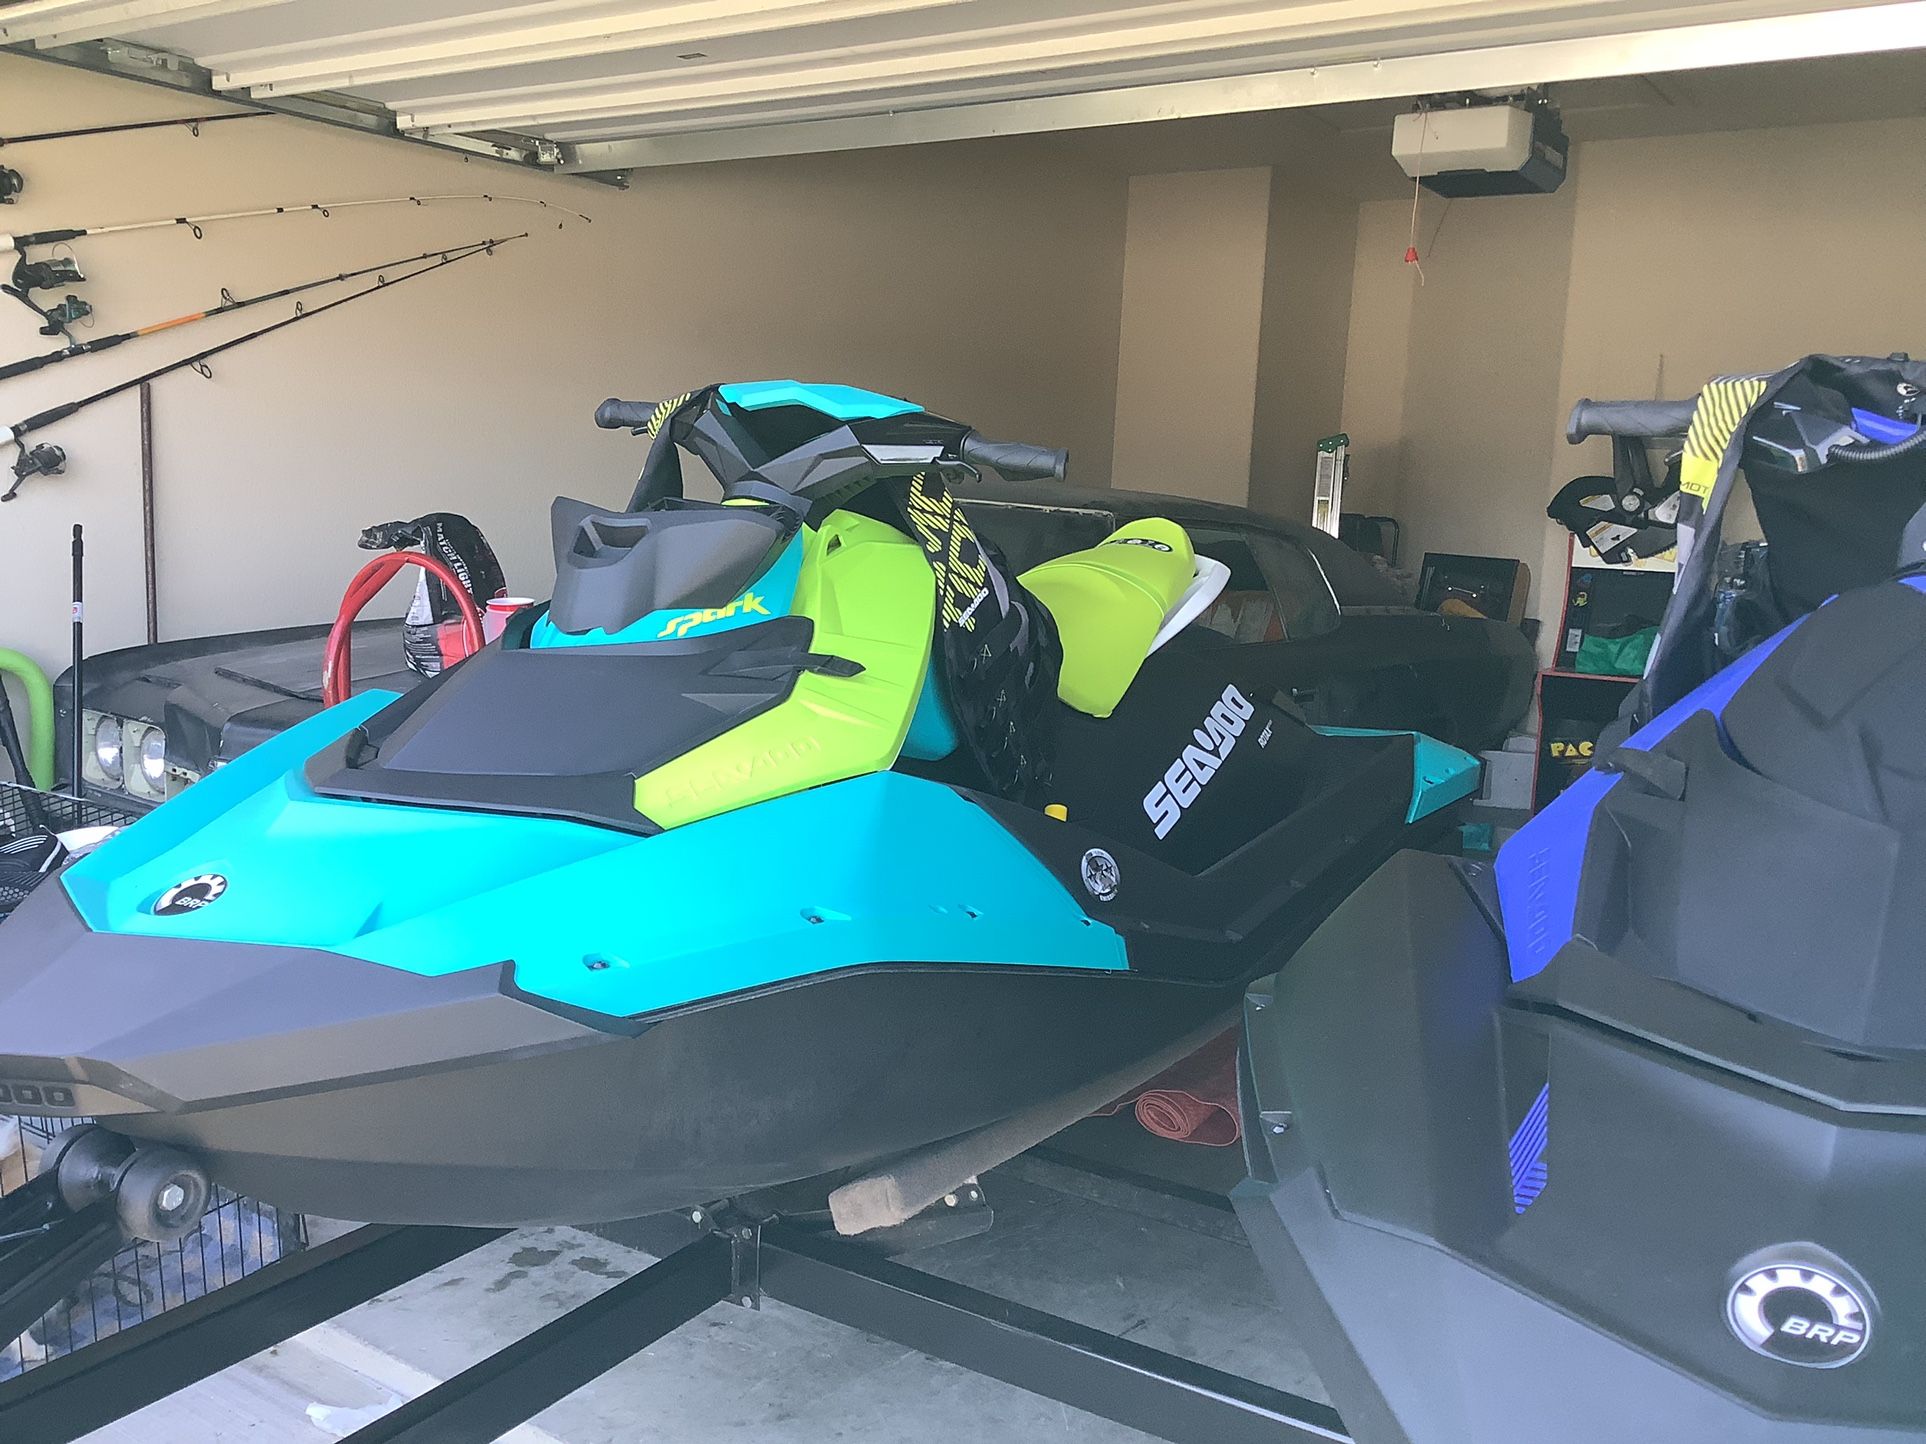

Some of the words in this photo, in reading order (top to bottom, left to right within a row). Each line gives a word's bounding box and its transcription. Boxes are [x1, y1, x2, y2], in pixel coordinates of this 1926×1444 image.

[436, 522, 456, 561] MATCH
[1550, 741, 1594, 757] PAC
[174, 896, 209, 909] BRP
[1780, 1315, 1861, 1345] BRP
